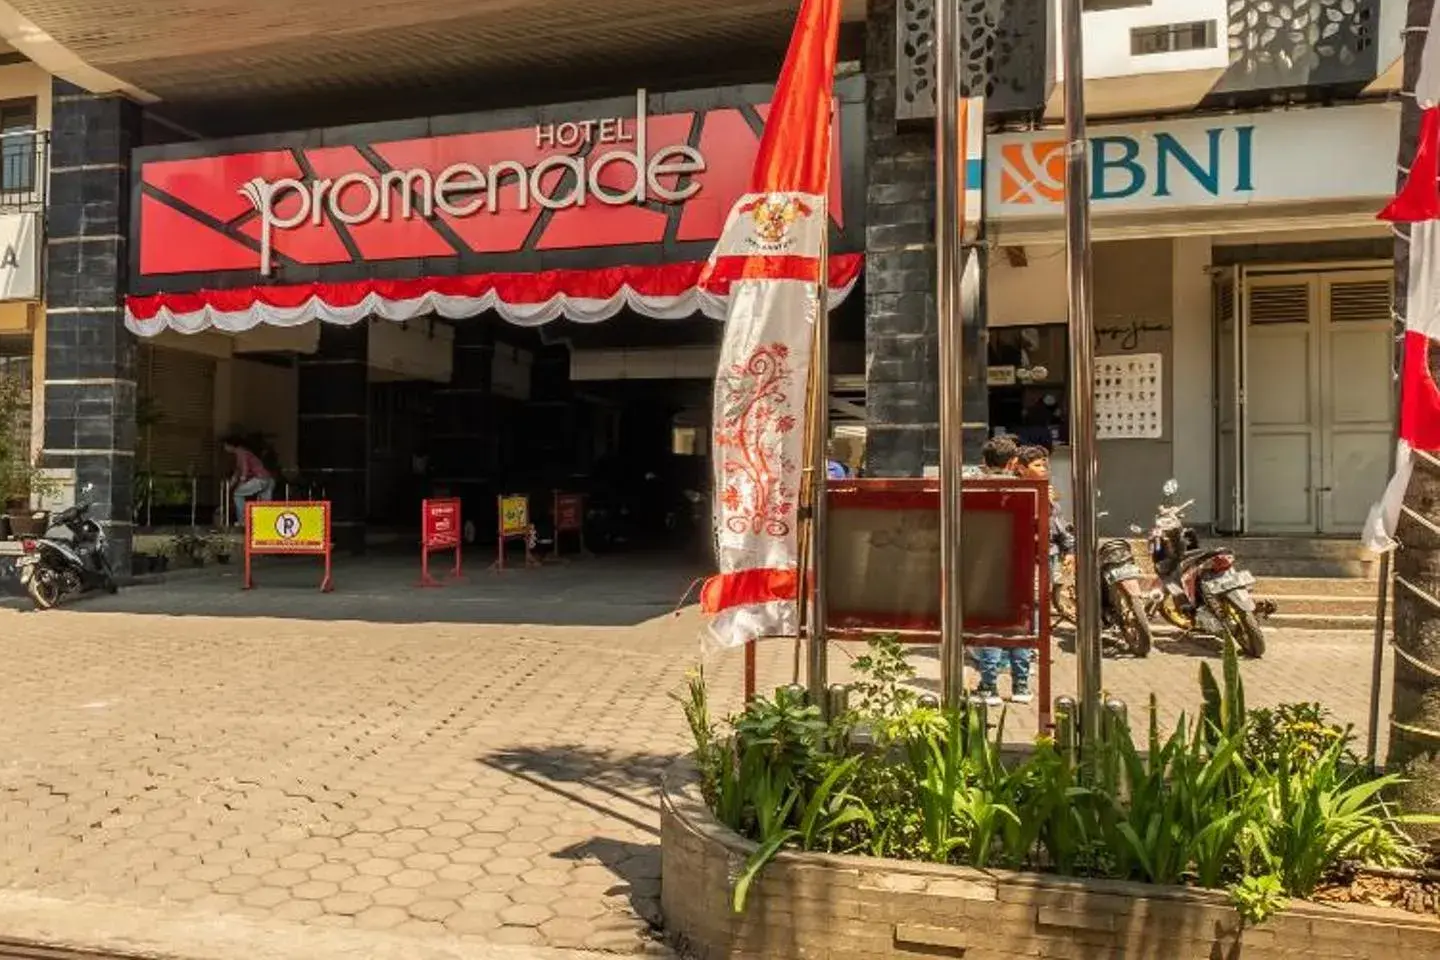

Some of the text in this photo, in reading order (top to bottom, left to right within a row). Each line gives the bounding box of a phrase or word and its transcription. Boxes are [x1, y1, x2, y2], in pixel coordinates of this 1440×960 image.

[535, 117, 633, 149] HOTEL
[1089, 125, 1256, 200] BNI
[236, 88, 707, 277] promenade
